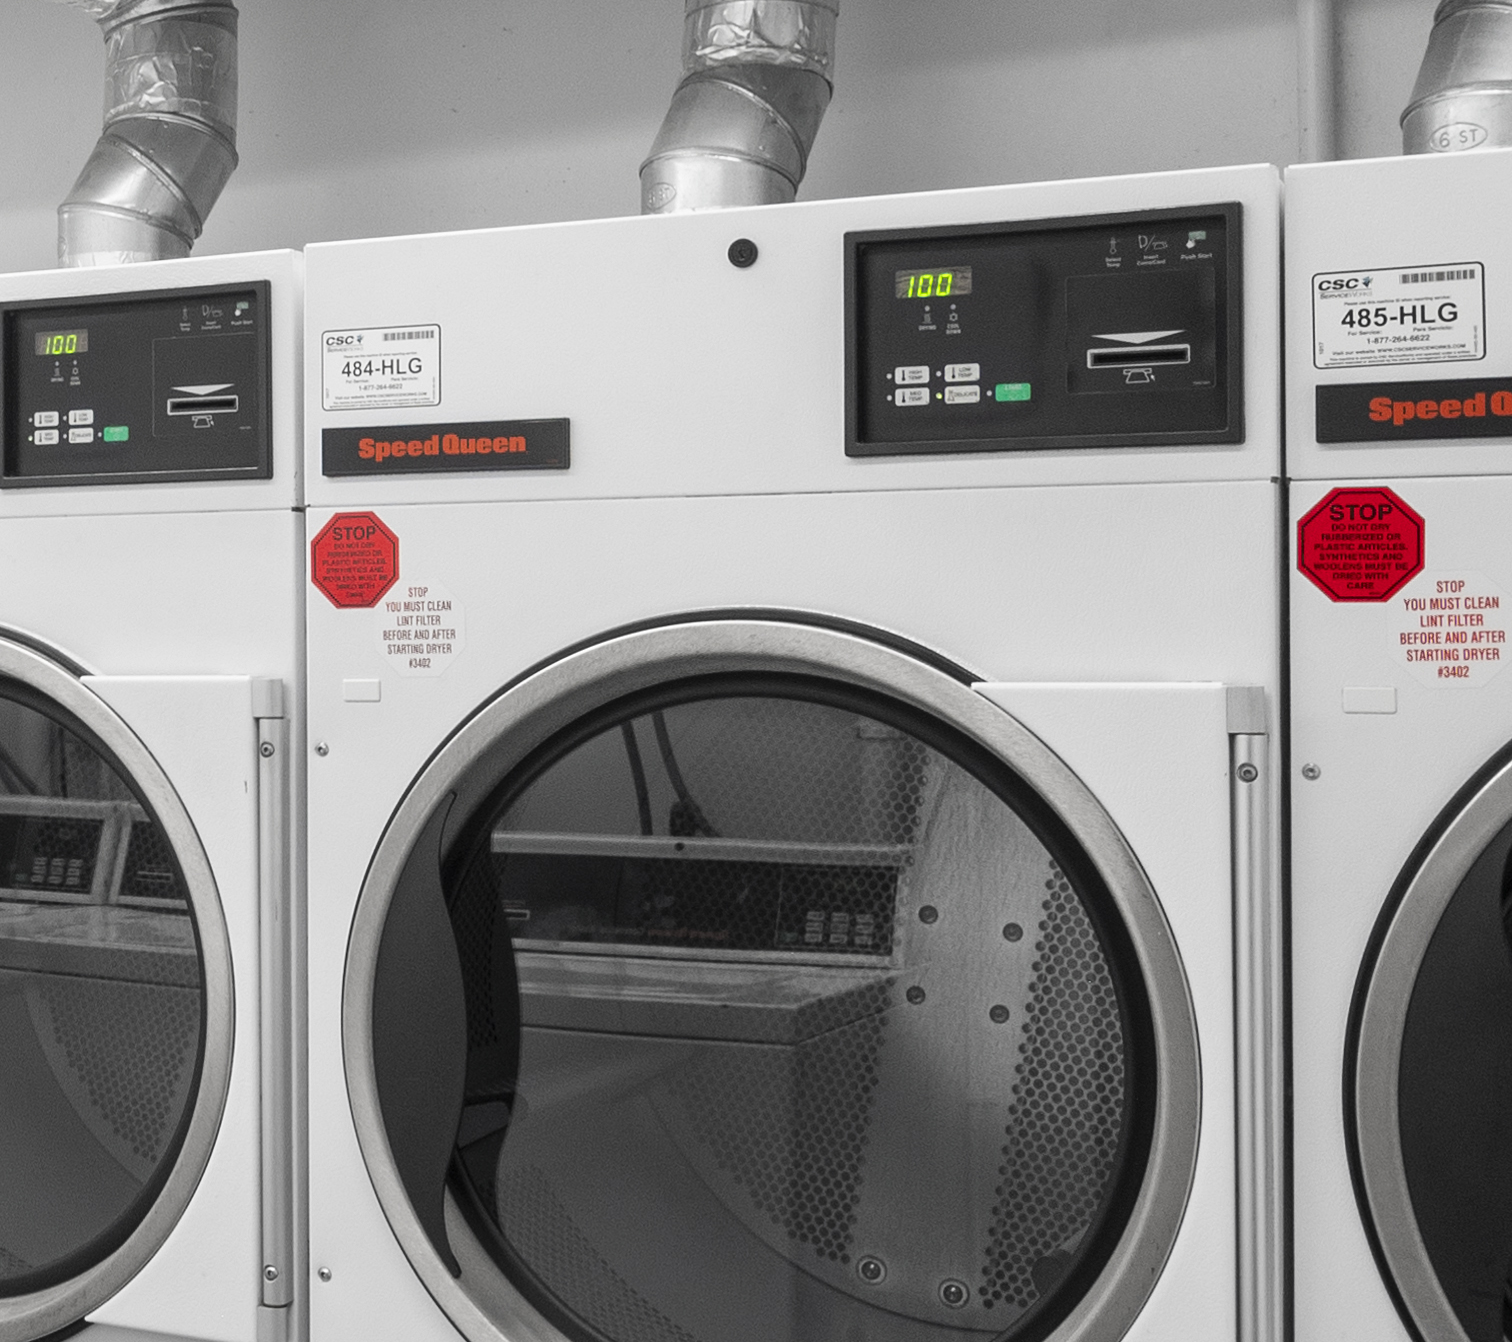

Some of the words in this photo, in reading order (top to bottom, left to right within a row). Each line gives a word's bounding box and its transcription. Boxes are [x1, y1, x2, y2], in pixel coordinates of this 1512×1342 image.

[1439, 131, 1450, 148] 6
[1459, 129, 1478, 143] ST
[908, 273, 953, 298] 100
[1318, 278, 1359, 291] CSC
[1341, 302, 1458, 328] 485-HLG
[46, 334, 77, 355] 100
[326, 336, 354, 345] CSC
[1366, 334, 1430, 344] 1-877-264-6622
[341, 358, 422, 377] 484-HLG
[1369, 393, 1486, 425] Speed
[358, 435, 439, 462] Speed
[442, 433, 526, 454] Queen
[1330, 504, 1392, 521] STOP
[332, 525, 376, 541] STOP
[1331, 523, 1346, 531] DO
[1347, 523, 1368, 531] NOT
[1370, 523, 1391, 531] DRY
[1387, 533, 1401, 541] OR
[1320, 553, 1379, 561] SYNTHETICS
[1314, 563, 1362, 571] WOOLENS
[408, 587, 428, 597] STOP
[1436, 580, 1465, 593] STOP
[385, 602, 401, 612] YOU
[404, 601, 425, 611] MUST
[427, 601, 452, 611] CLEAN
[1403, 598, 1426, 611] YOU
[1430, 598, 1461, 610] MUST
[1464, 596, 1499, 609] CLEAN
[397, 616, 413, 626] LINT
[416, 615, 441, 625] FILTER
[1420, 615, 1444, 627] LINT
[1447, 614, 1484, 627] FILTER
[383, 630, 412, 640] BEFORE
[414, 629, 430, 640] AND
[432, 629, 456, 639] AFTER
[1400, 632, 1442, 645] BEFORE
[1445, 631, 1467, 644] AND
[1471, 630, 1506, 643] AFTER
[388, 644, 424, 654] STARTING
[426, 643, 452, 654] DRYER
[1406, 649, 1459, 662] STARTING
[1463, 648, 1500, 661] DRYER
[1438, 666, 1469, 678] #3402
